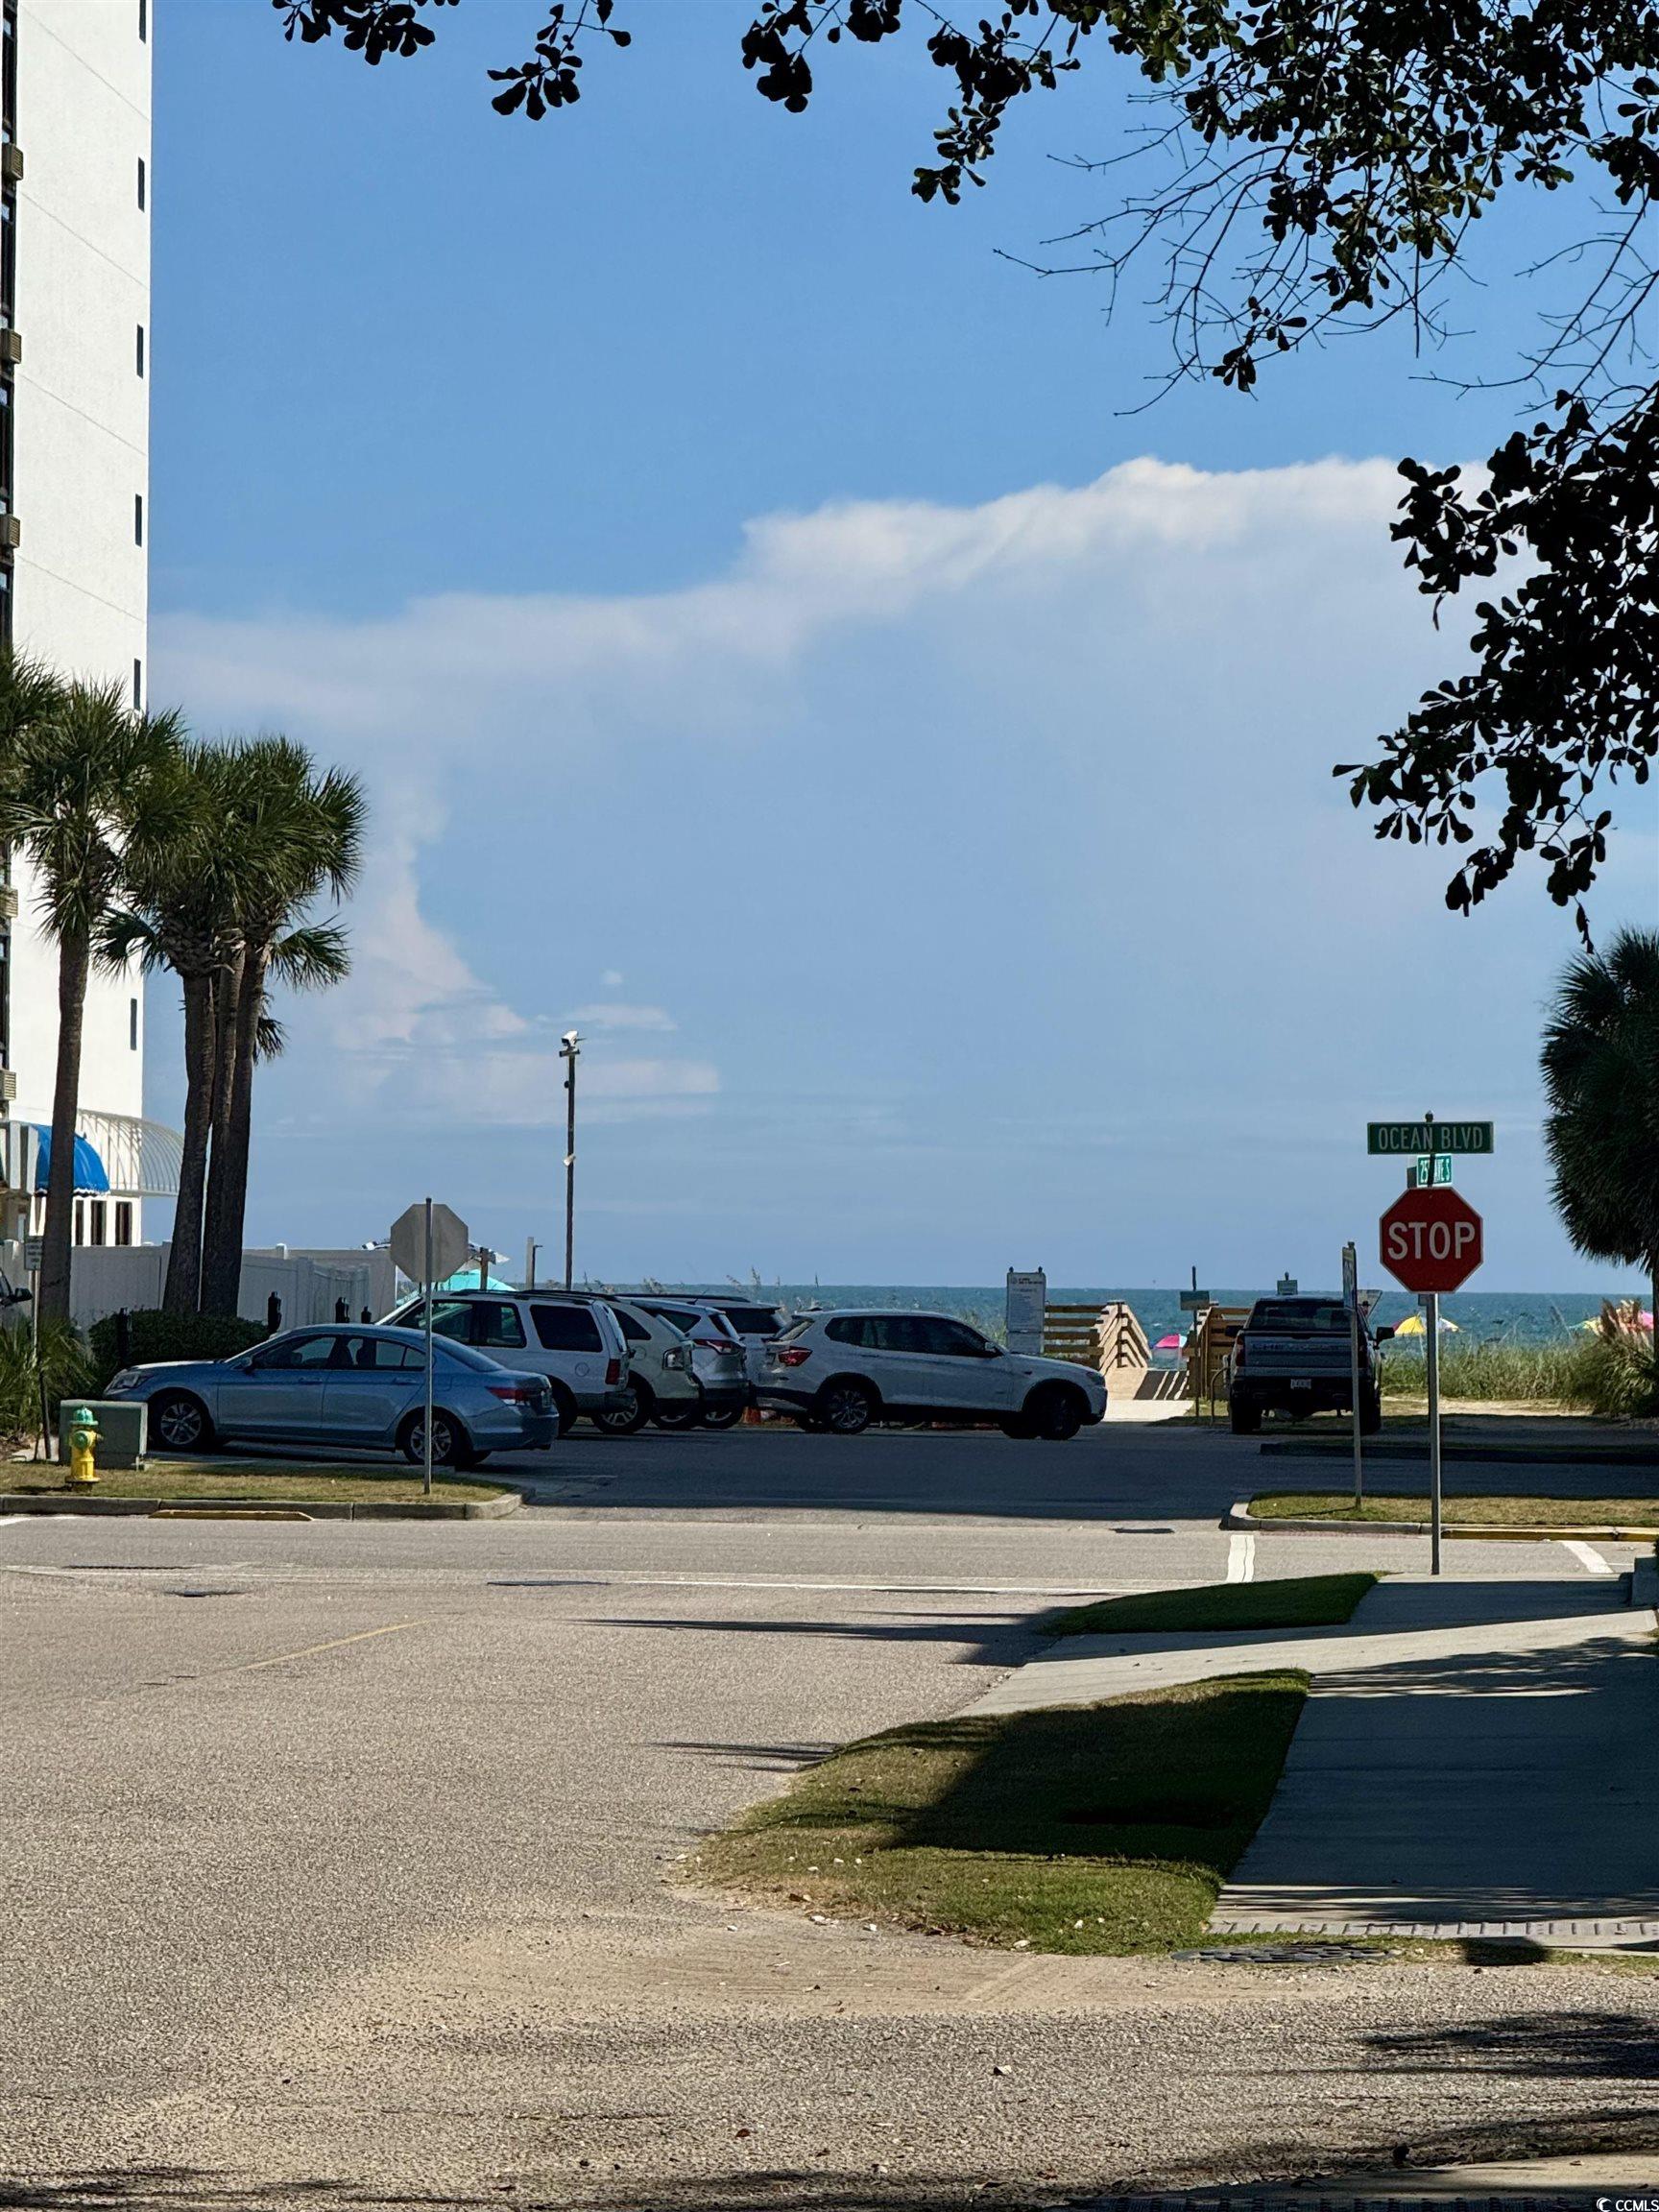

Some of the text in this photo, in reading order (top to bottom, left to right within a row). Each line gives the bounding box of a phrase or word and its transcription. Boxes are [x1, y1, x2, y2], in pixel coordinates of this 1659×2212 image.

[1378, 1126, 1483, 1150] OCEAN BLVD
[1420, 1159, 1431, 1183] 25
[1387, 1221, 1476, 1261] STOP
